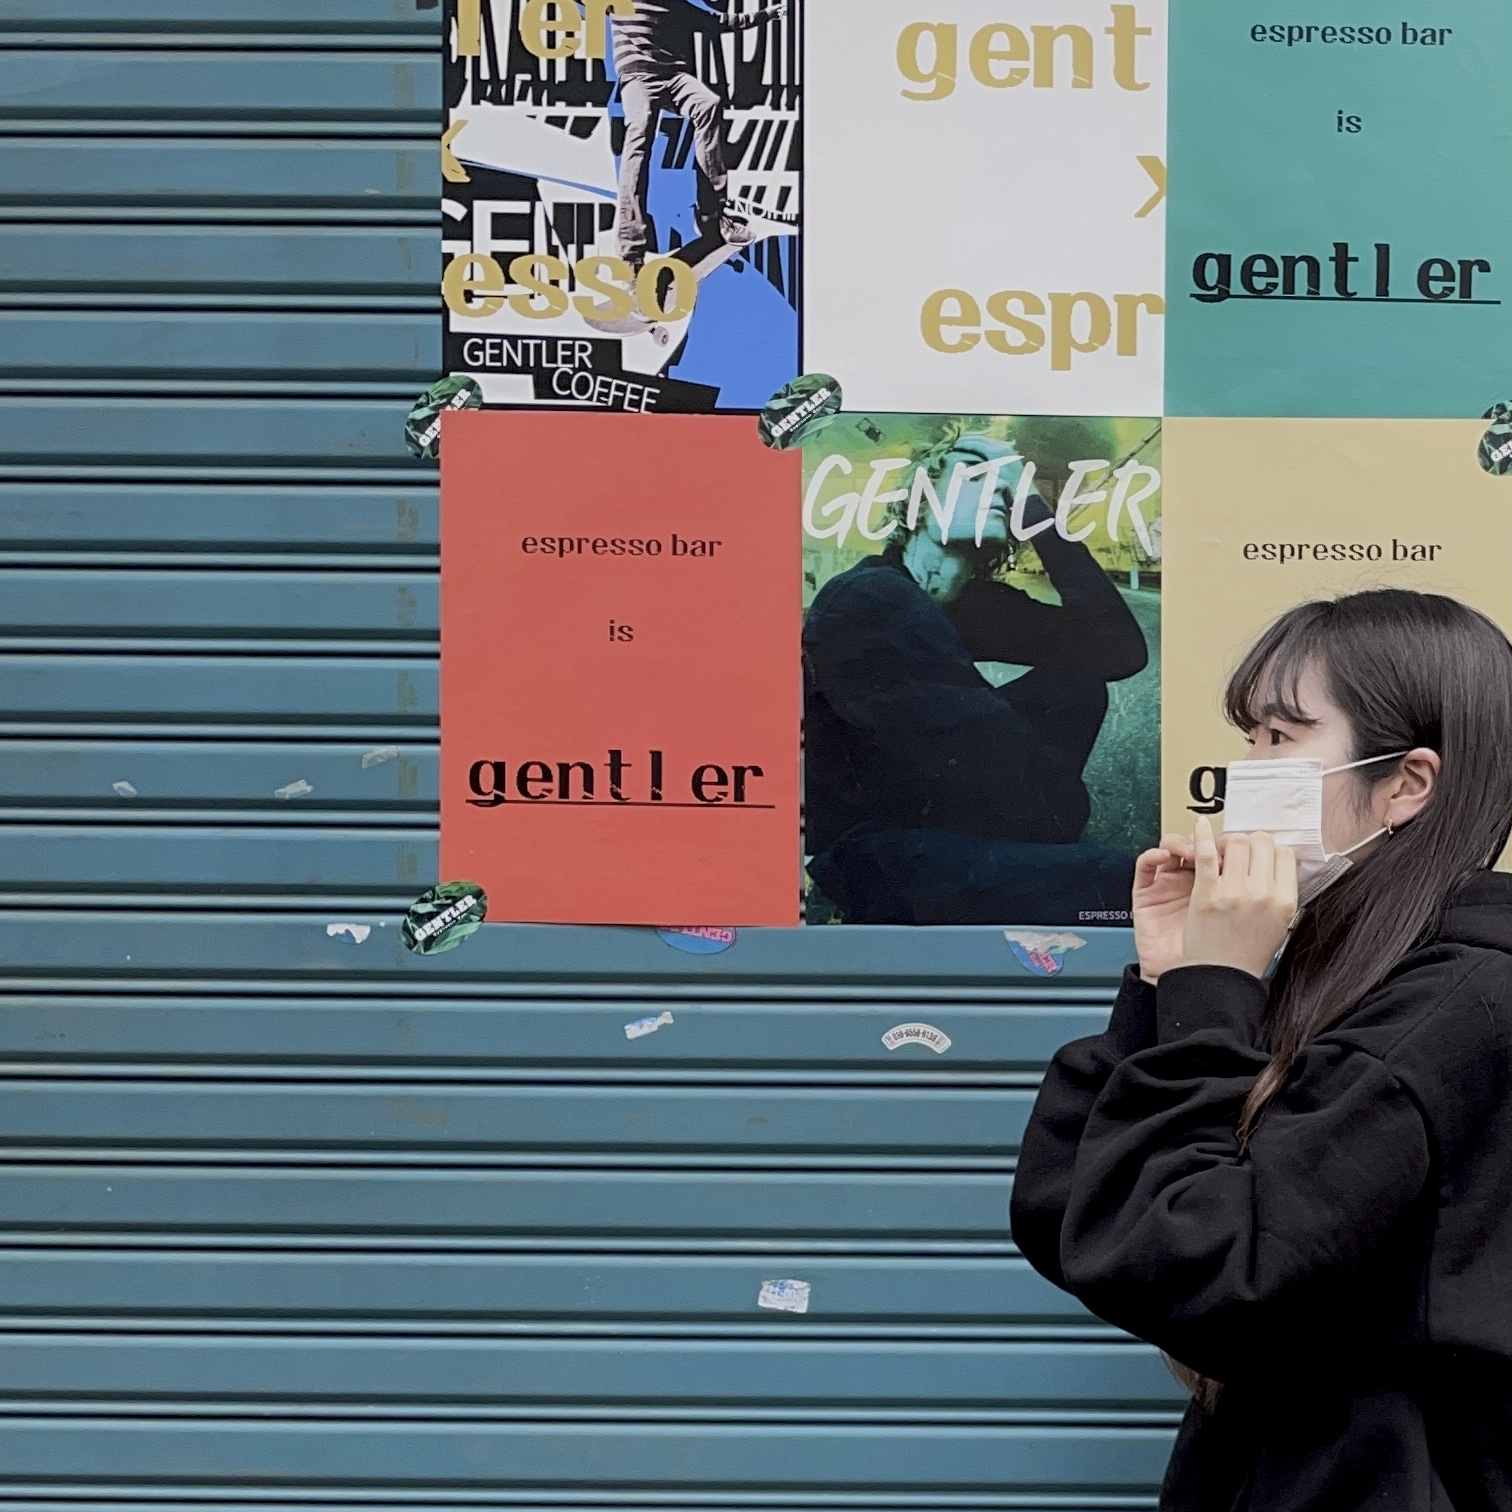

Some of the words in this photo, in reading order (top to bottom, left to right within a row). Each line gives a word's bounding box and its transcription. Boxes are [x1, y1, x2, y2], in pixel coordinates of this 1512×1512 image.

[896, 4, 1152, 101] gent
[1250, 23, 1392, 47] espresso
[1401, 21, 1453, 46] bar
[1336, 109, 1362, 133] is
[442, 253, 697, 322] esso
[920, 288, 1166, 371] espr
[462, 337, 593, 369] GENTLER
[551, 367, 660, 414] COFFEE
[770, 387, 832, 437] GENTLER
[801, 453, 1161, 557] GENTLER
[521, 535, 662, 558] espresso
[671, 534, 722, 557] bar
[1242, 540, 1383, 564] espresso
[1392, 538, 1442, 562] bar
[608, 619, 635, 643] is
[414, 895, 477, 941] GENTLER
[1078, 910, 1129, 920] ESPRESSO
